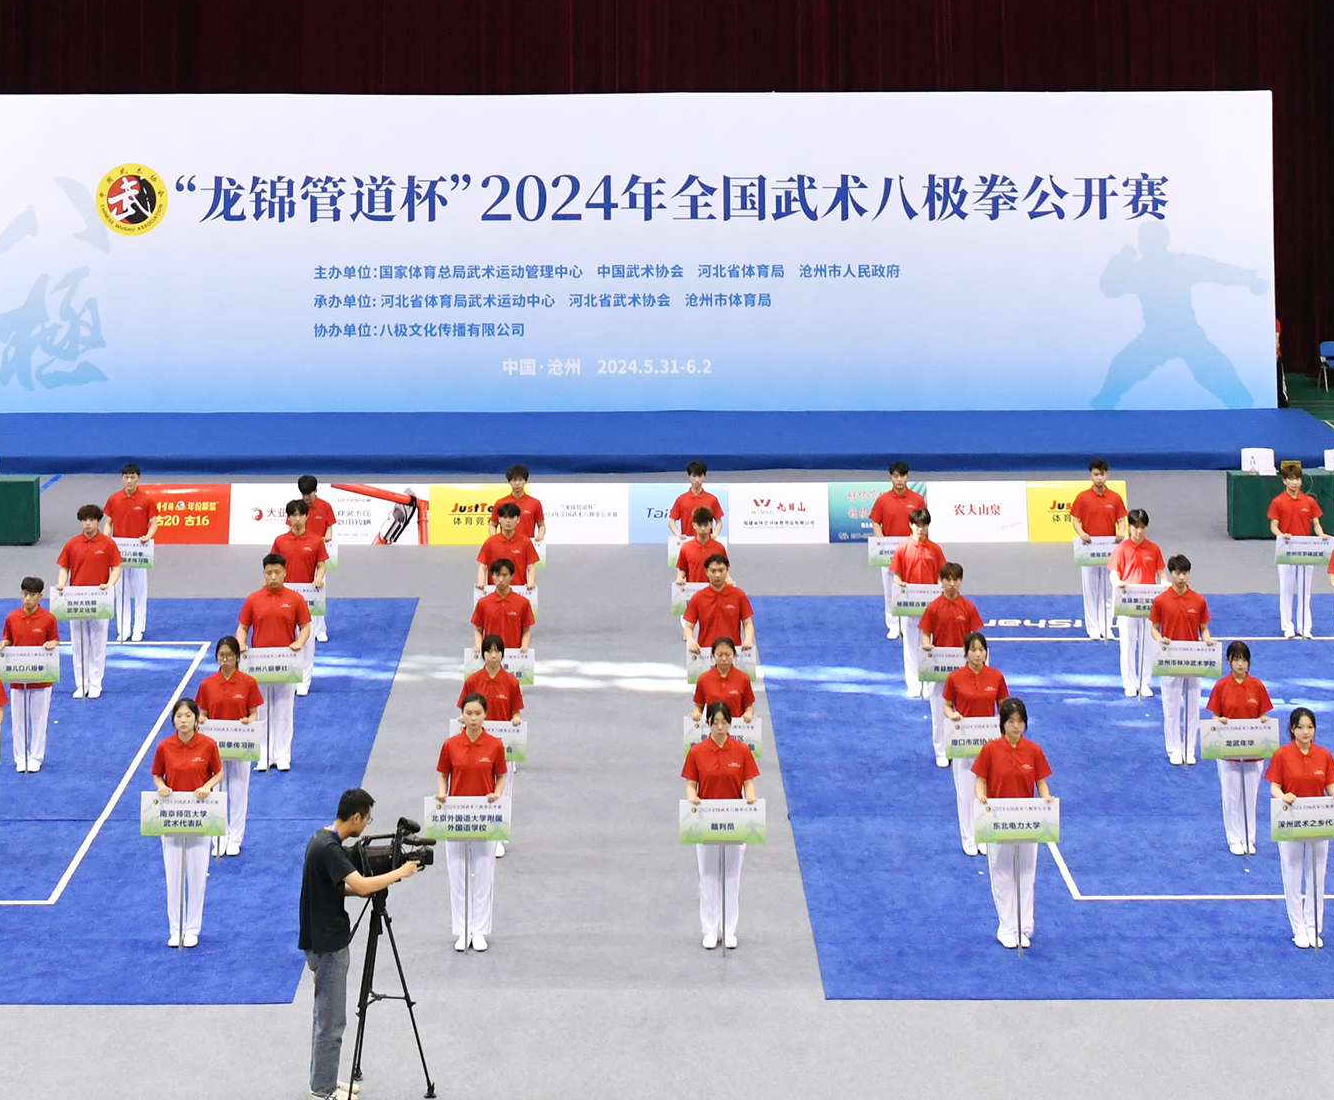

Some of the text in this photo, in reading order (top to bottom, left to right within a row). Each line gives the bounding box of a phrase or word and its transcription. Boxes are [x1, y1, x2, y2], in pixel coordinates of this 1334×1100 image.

[115, 223, 135, 232] WUSHU
[137, 203, 163, 231] ASSOCIATION
[597, 263, 684, 280] 中国武术协会
[698, 263, 785, 280] 河北省体育局
[799, 263, 901, 280] 沧州市人民政府
[569, 293, 671, 309] 河北省武术协会
[685, 293, 772, 309] 沧州市体育局
[502, 358, 712, 376] 中国·沧州 2024.5.31-6.2
[777, 502, 806, 512] 九日山
[953, 503, 1001, 516] 农夫山泉
[184, 515, 210, 526] 古16
[447, 824, 486, 832] 外国语学校
[993, 822, 1040, 830] 东北电力大学
